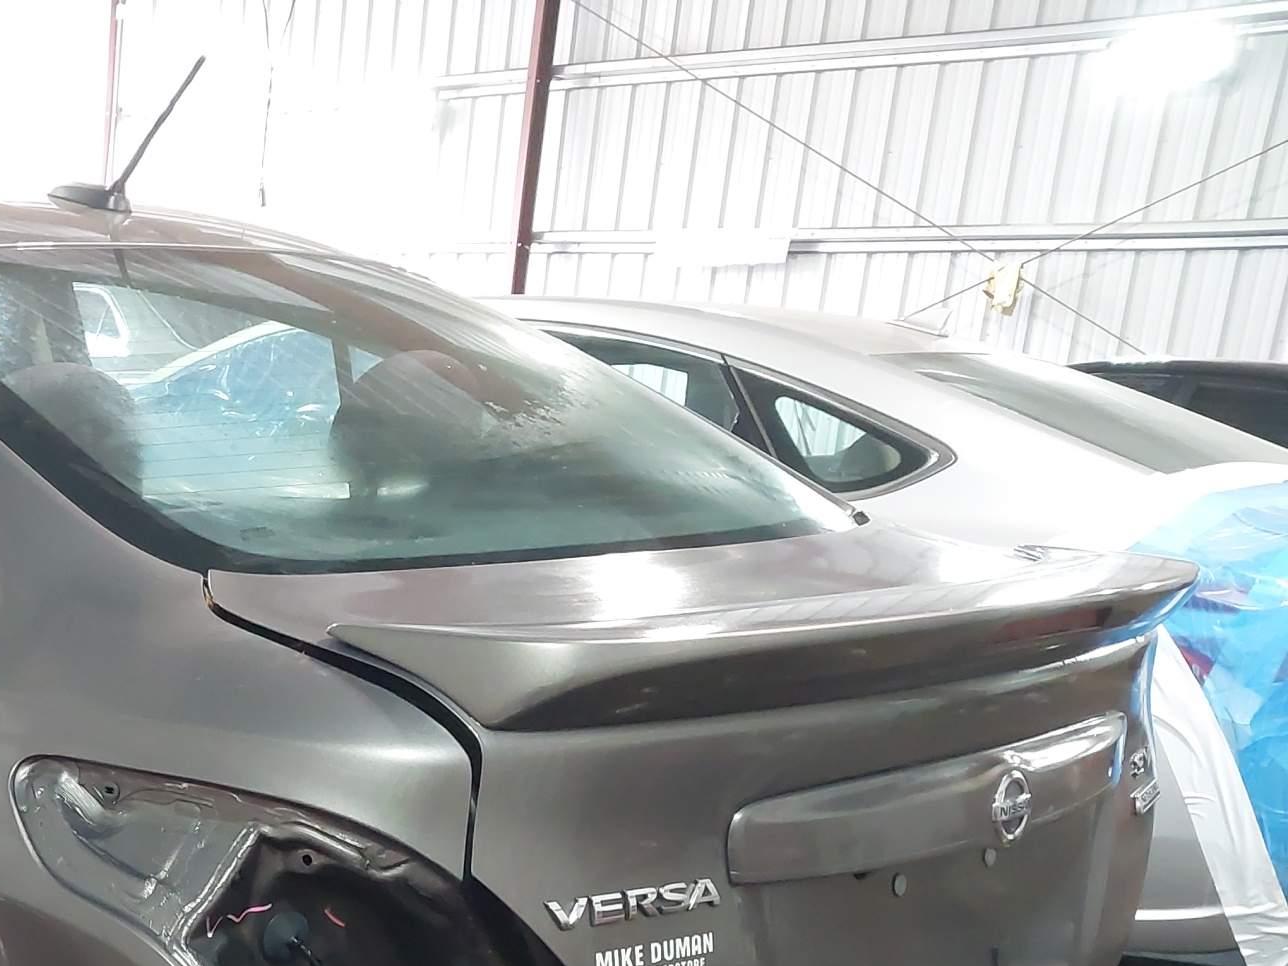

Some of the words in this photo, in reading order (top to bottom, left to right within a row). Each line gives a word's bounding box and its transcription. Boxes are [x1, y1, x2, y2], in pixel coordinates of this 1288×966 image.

[999, 797, 1031, 818] NISS
[544, 878, 721, 930] VERSA
[650, 931, 714, 964] DUMAN
